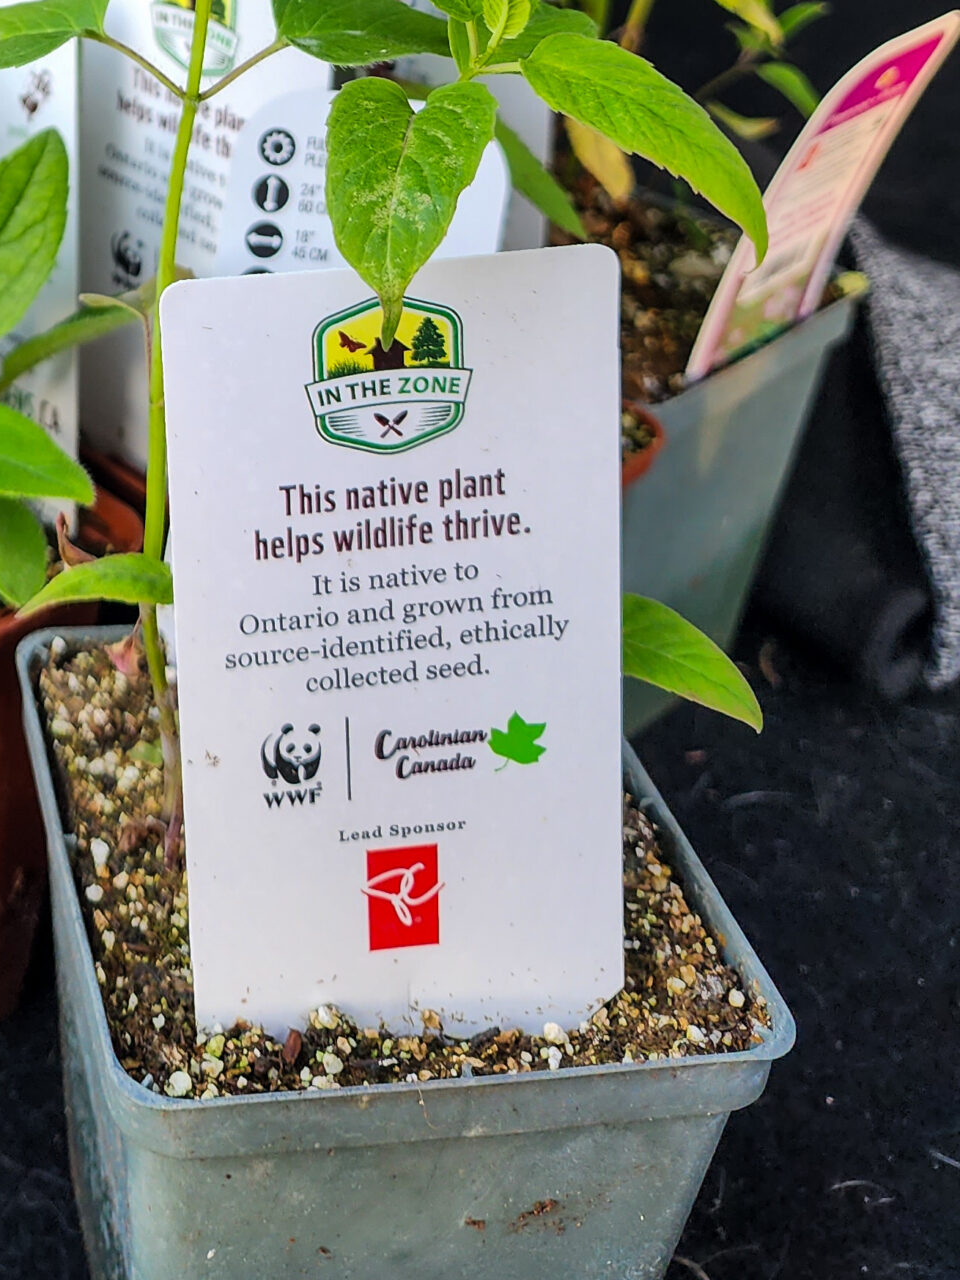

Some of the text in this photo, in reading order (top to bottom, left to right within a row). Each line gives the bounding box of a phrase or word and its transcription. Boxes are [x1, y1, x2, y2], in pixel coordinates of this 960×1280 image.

[317, 376, 461, 407] IN THE ZONE
[278, 468, 506, 517] This native plant
[254, 508, 531, 564] helps wildlife thrive.
[312, 562, 479, 596] It is native to
[239, 587, 554, 636] Ontario and grown from
[225, 614, 570, 672] source-identified, ethically
[306, 653, 490, 693] collected seed.
[374, 729, 488, 762] Carolinian
[395, 752, 477, 780] Canada
[263, 786, 320, 809] WWF
[339, 820, 467, 843] Lead Sponsor
